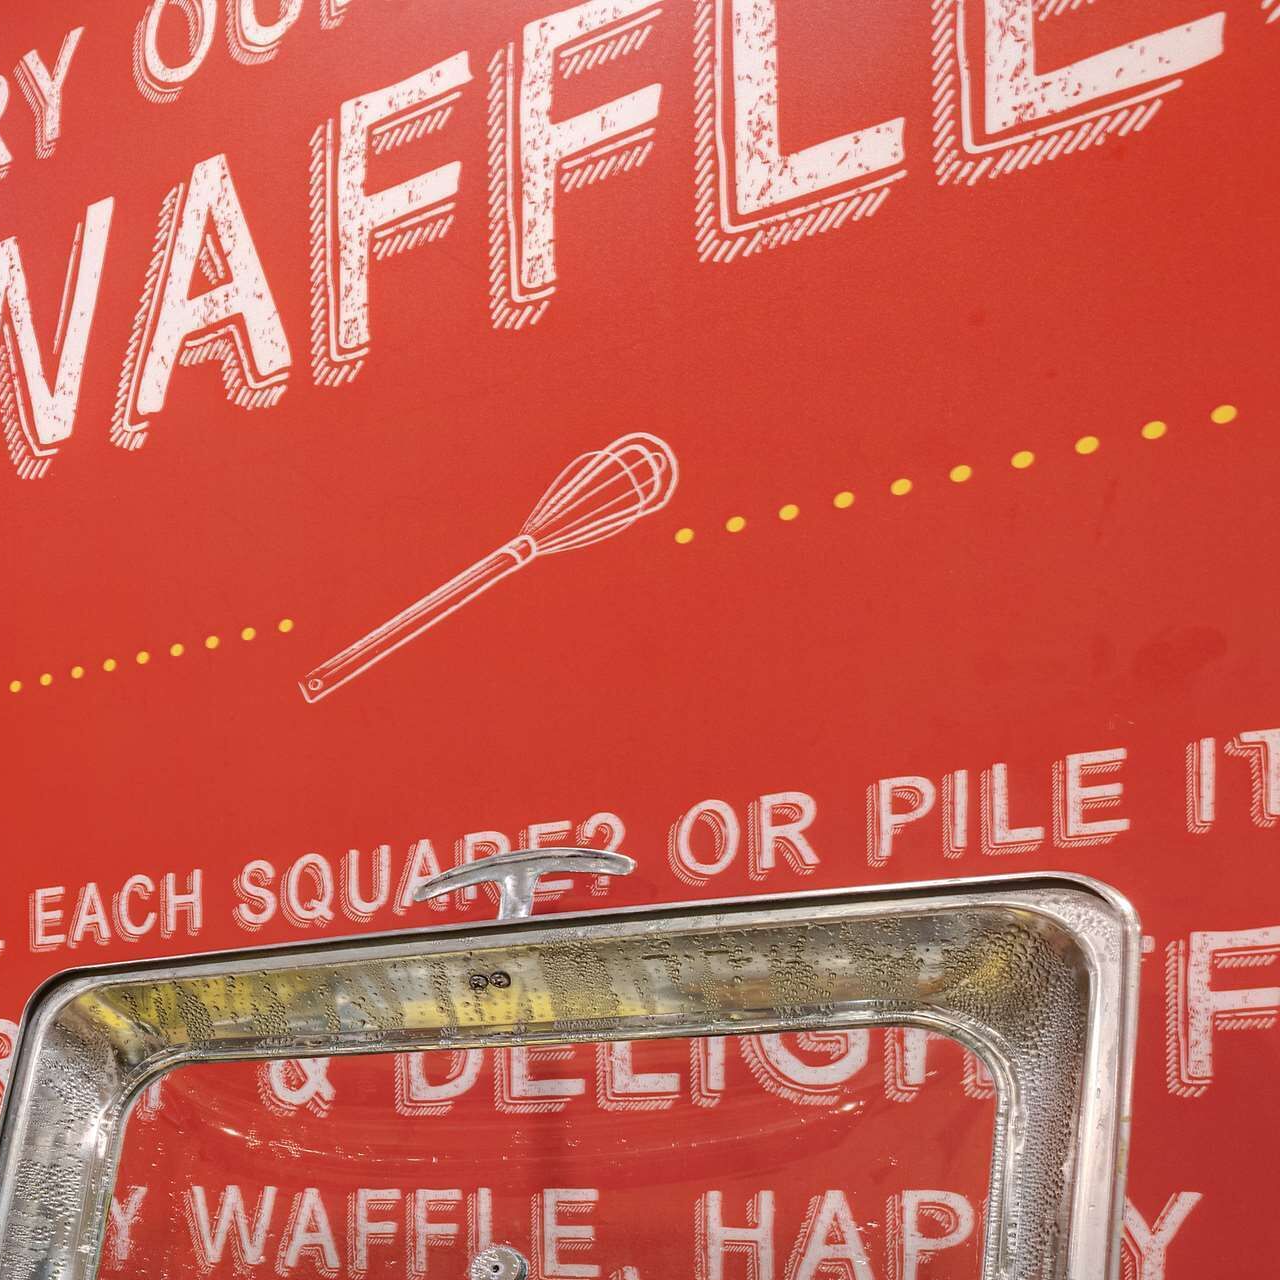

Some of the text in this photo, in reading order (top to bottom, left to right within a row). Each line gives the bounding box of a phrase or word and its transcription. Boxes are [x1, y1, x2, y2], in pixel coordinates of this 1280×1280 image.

[29, 868, 203, 953] EACH
[667, 791, 820, 887] OR
[866, 747, 1131, 868] PILE
